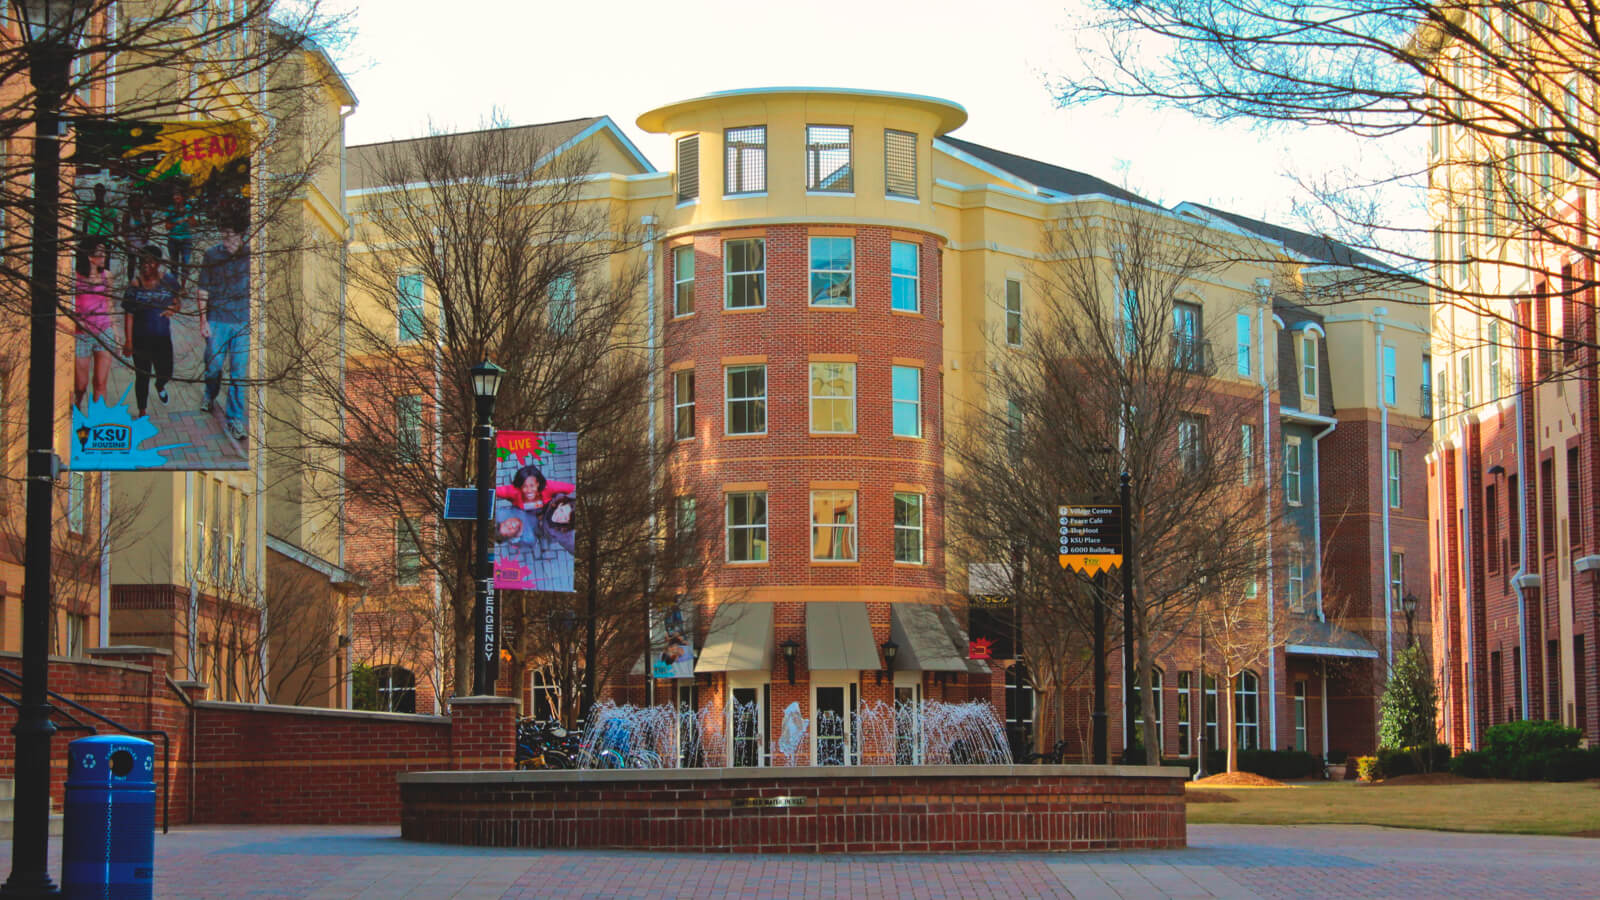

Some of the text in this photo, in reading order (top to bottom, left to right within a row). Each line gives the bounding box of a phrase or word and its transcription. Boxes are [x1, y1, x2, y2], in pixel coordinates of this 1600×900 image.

[181, 134, 237, 161] LEAD
[93, 429, 126, 441] KSU
[509, 438, 531, 450] LIVE
